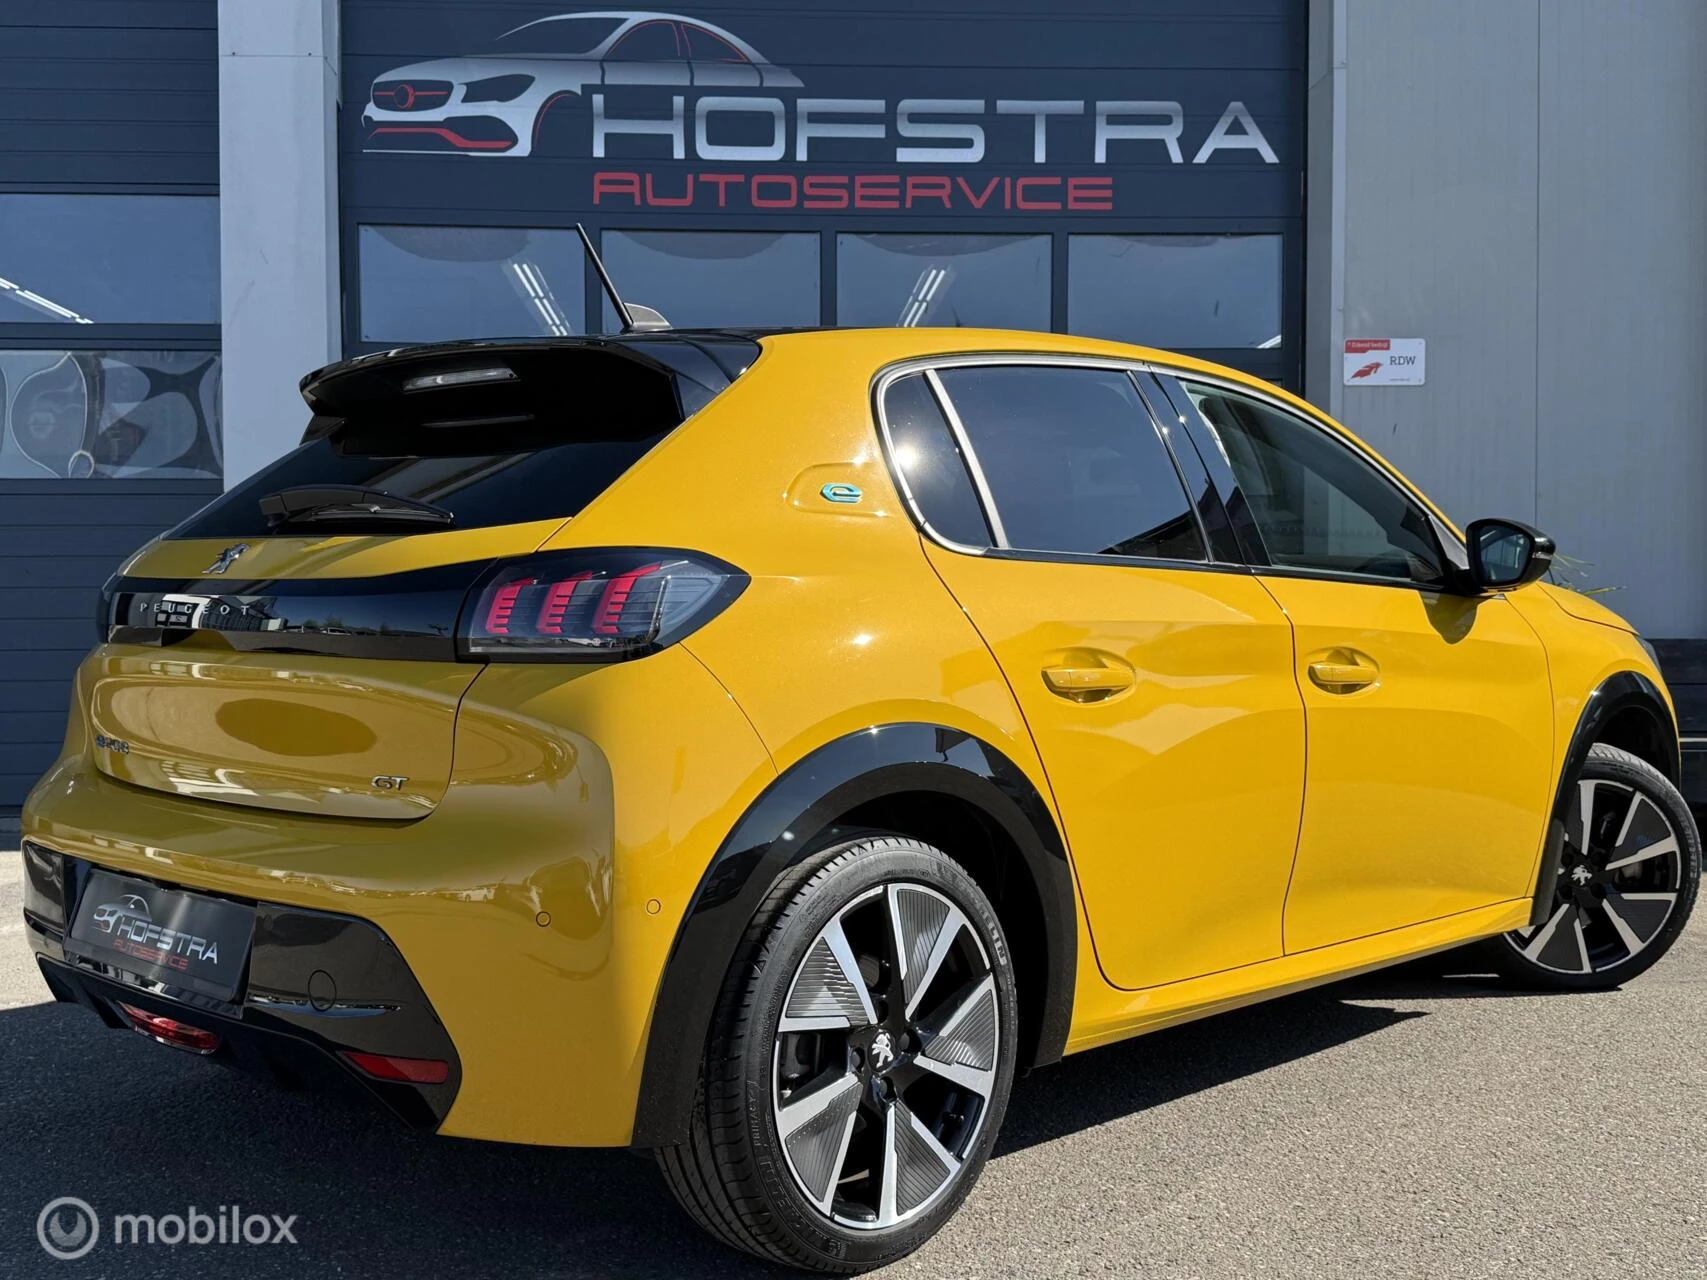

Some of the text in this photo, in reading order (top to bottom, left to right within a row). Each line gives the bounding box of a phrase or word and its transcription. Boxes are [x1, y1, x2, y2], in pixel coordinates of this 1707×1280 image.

[592, 94, 1279, 164] HOFSTRA
[592, 172, 1113, 210] AUTOSERVICE
[1389, 355, 1416, 366] RDW
[139, 603, 250, 616] PEUGEOT
[371, 775, 410, 790] GT
[117, 917, 218, 964] HOFSTRA
